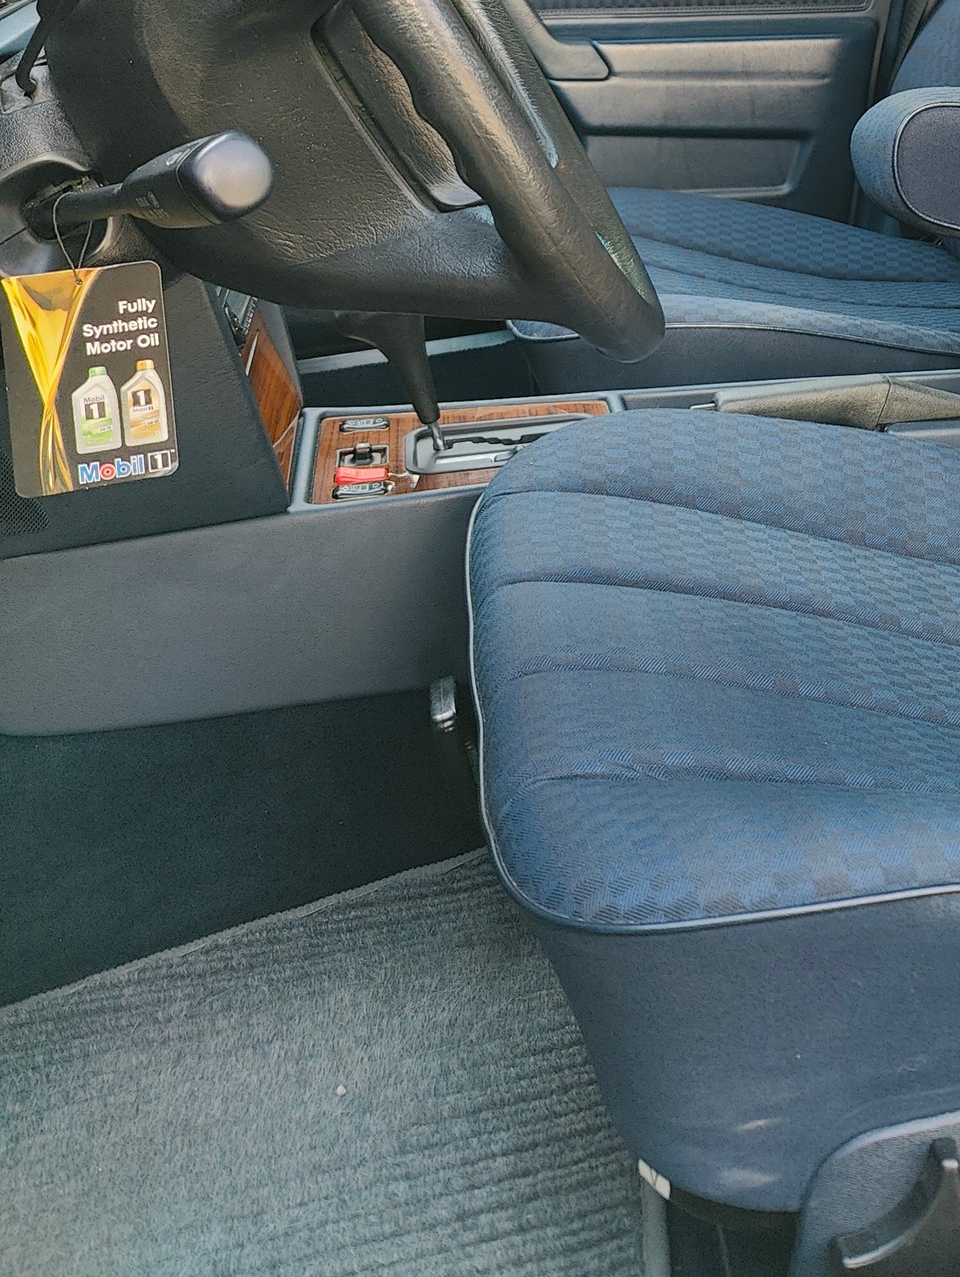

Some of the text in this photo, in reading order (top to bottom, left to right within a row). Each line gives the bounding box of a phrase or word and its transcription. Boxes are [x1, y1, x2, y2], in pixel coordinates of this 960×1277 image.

[118, 298, 156, 314] Fully
[82, 316, 158, 339] Synthetic
[85, 332, 160, 356] Motor Oil
[83, 395, 105, 404] Mobil
[78, 454, 145, 484] Mobil
